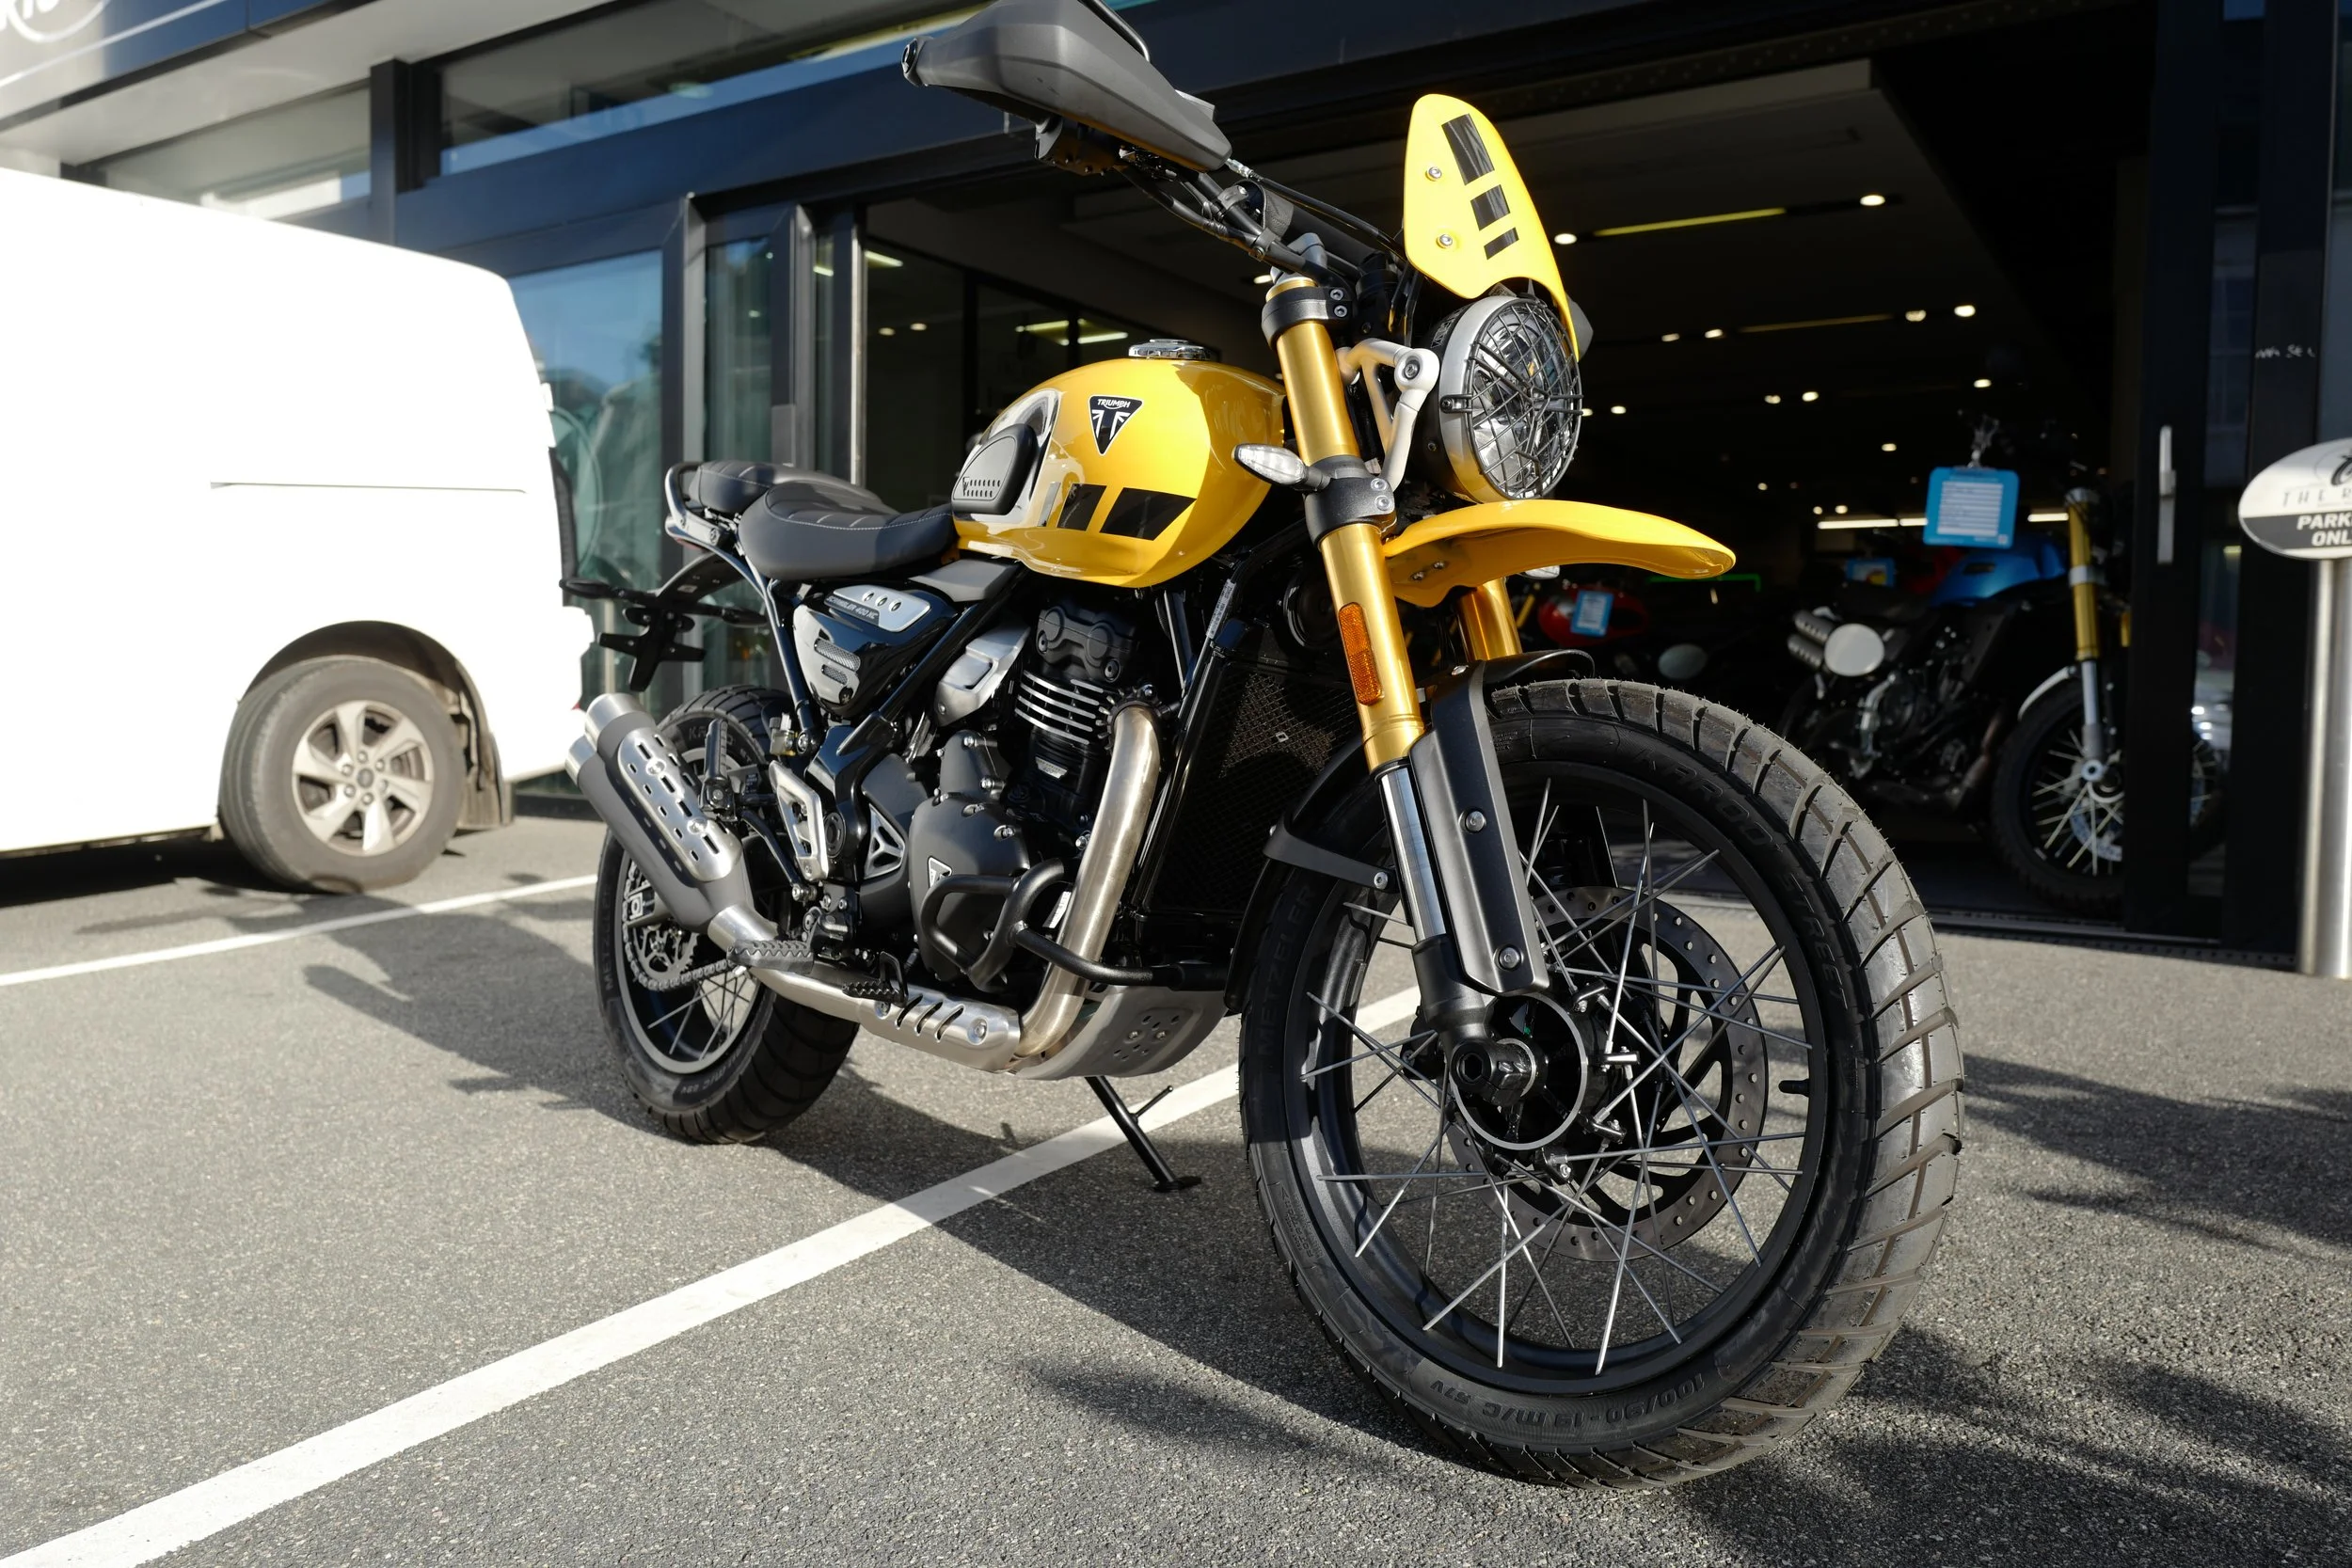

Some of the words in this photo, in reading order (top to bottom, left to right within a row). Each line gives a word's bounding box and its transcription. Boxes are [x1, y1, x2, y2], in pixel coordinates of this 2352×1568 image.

[1097, 398, 1131, 410] TRIUMPH
[2282, 489, 2326, 508] THE
[2296, 512, 2352, 531] PARK
[2312, 530, 2352, 546] ONL
[855, 605, 868, 616] 400
[1258, 884, 1314, 1055] METZELER
[1429, 1379, 1472, 1405] 57V
